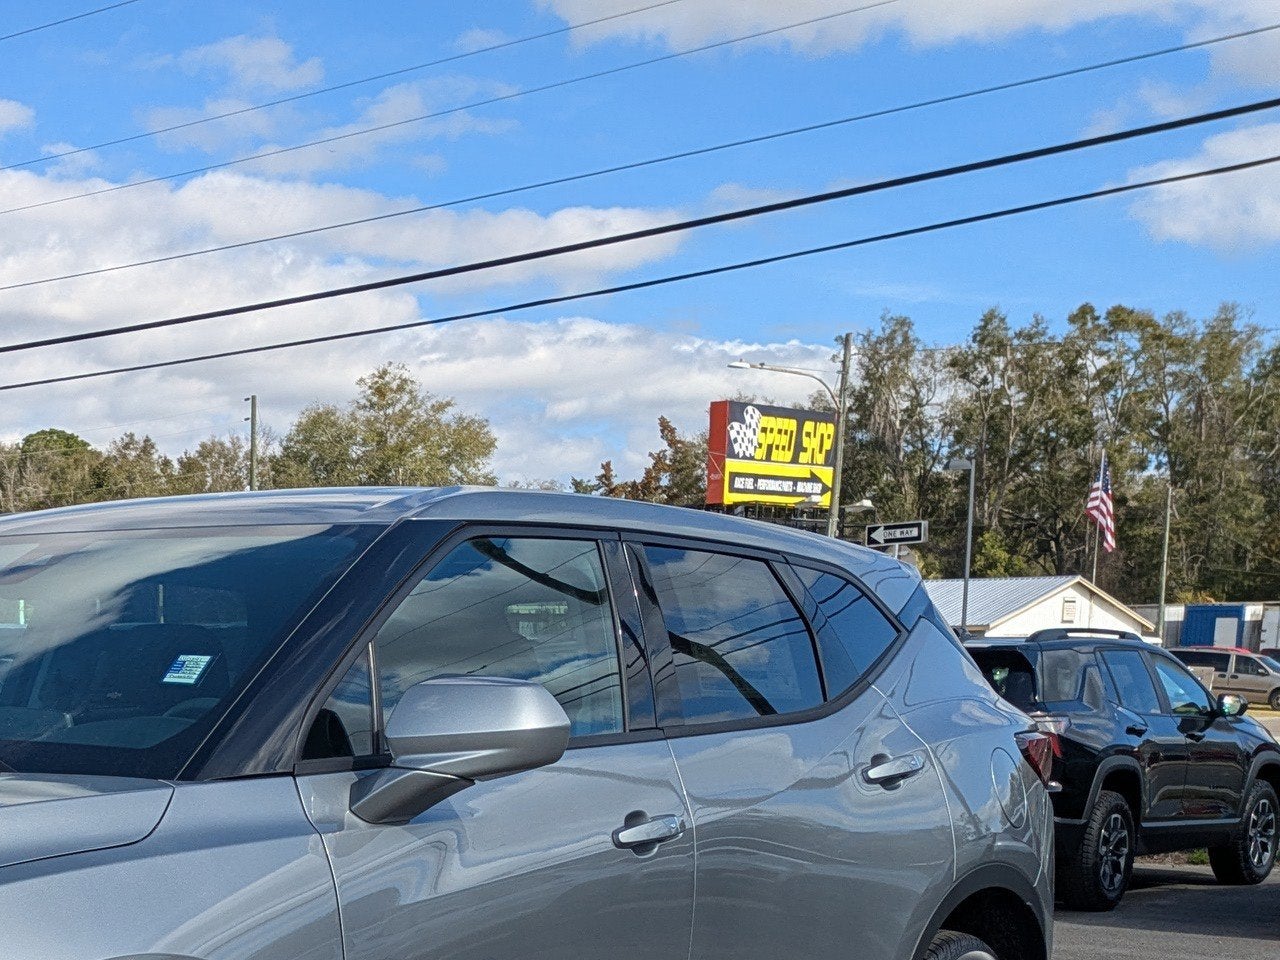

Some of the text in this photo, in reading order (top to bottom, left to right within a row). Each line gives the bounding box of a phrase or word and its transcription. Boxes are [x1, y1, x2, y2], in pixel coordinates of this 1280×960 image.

[754, 415, 835, 465] SPEED SHOP
[883, 529, 914, 539] ONE WAY
